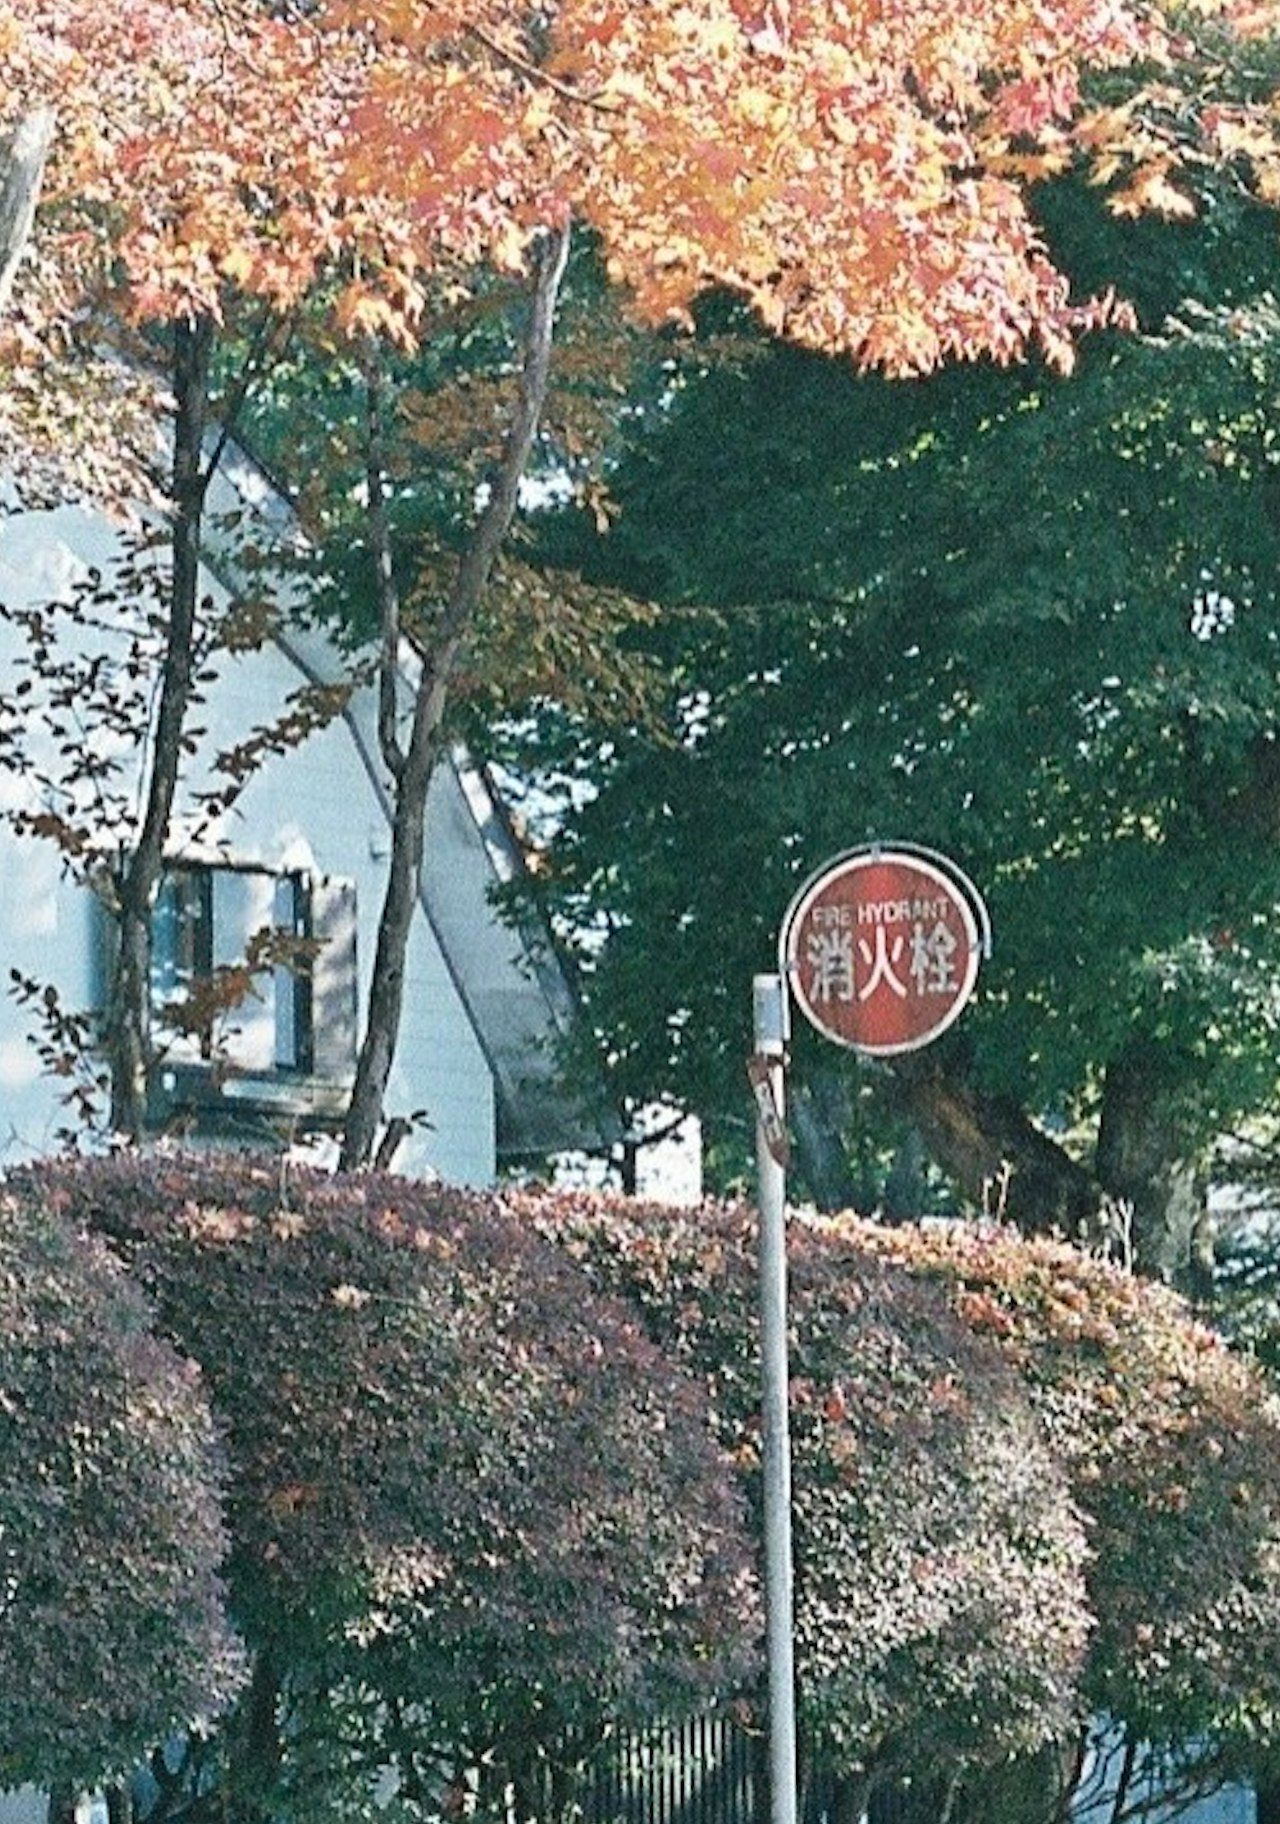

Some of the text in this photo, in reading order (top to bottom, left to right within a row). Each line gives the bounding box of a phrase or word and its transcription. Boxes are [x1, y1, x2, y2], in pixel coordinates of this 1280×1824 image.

[811, 898, 949, 926] FIRE HYDRANT
[807, 922, 958, 1003] 消火栓
